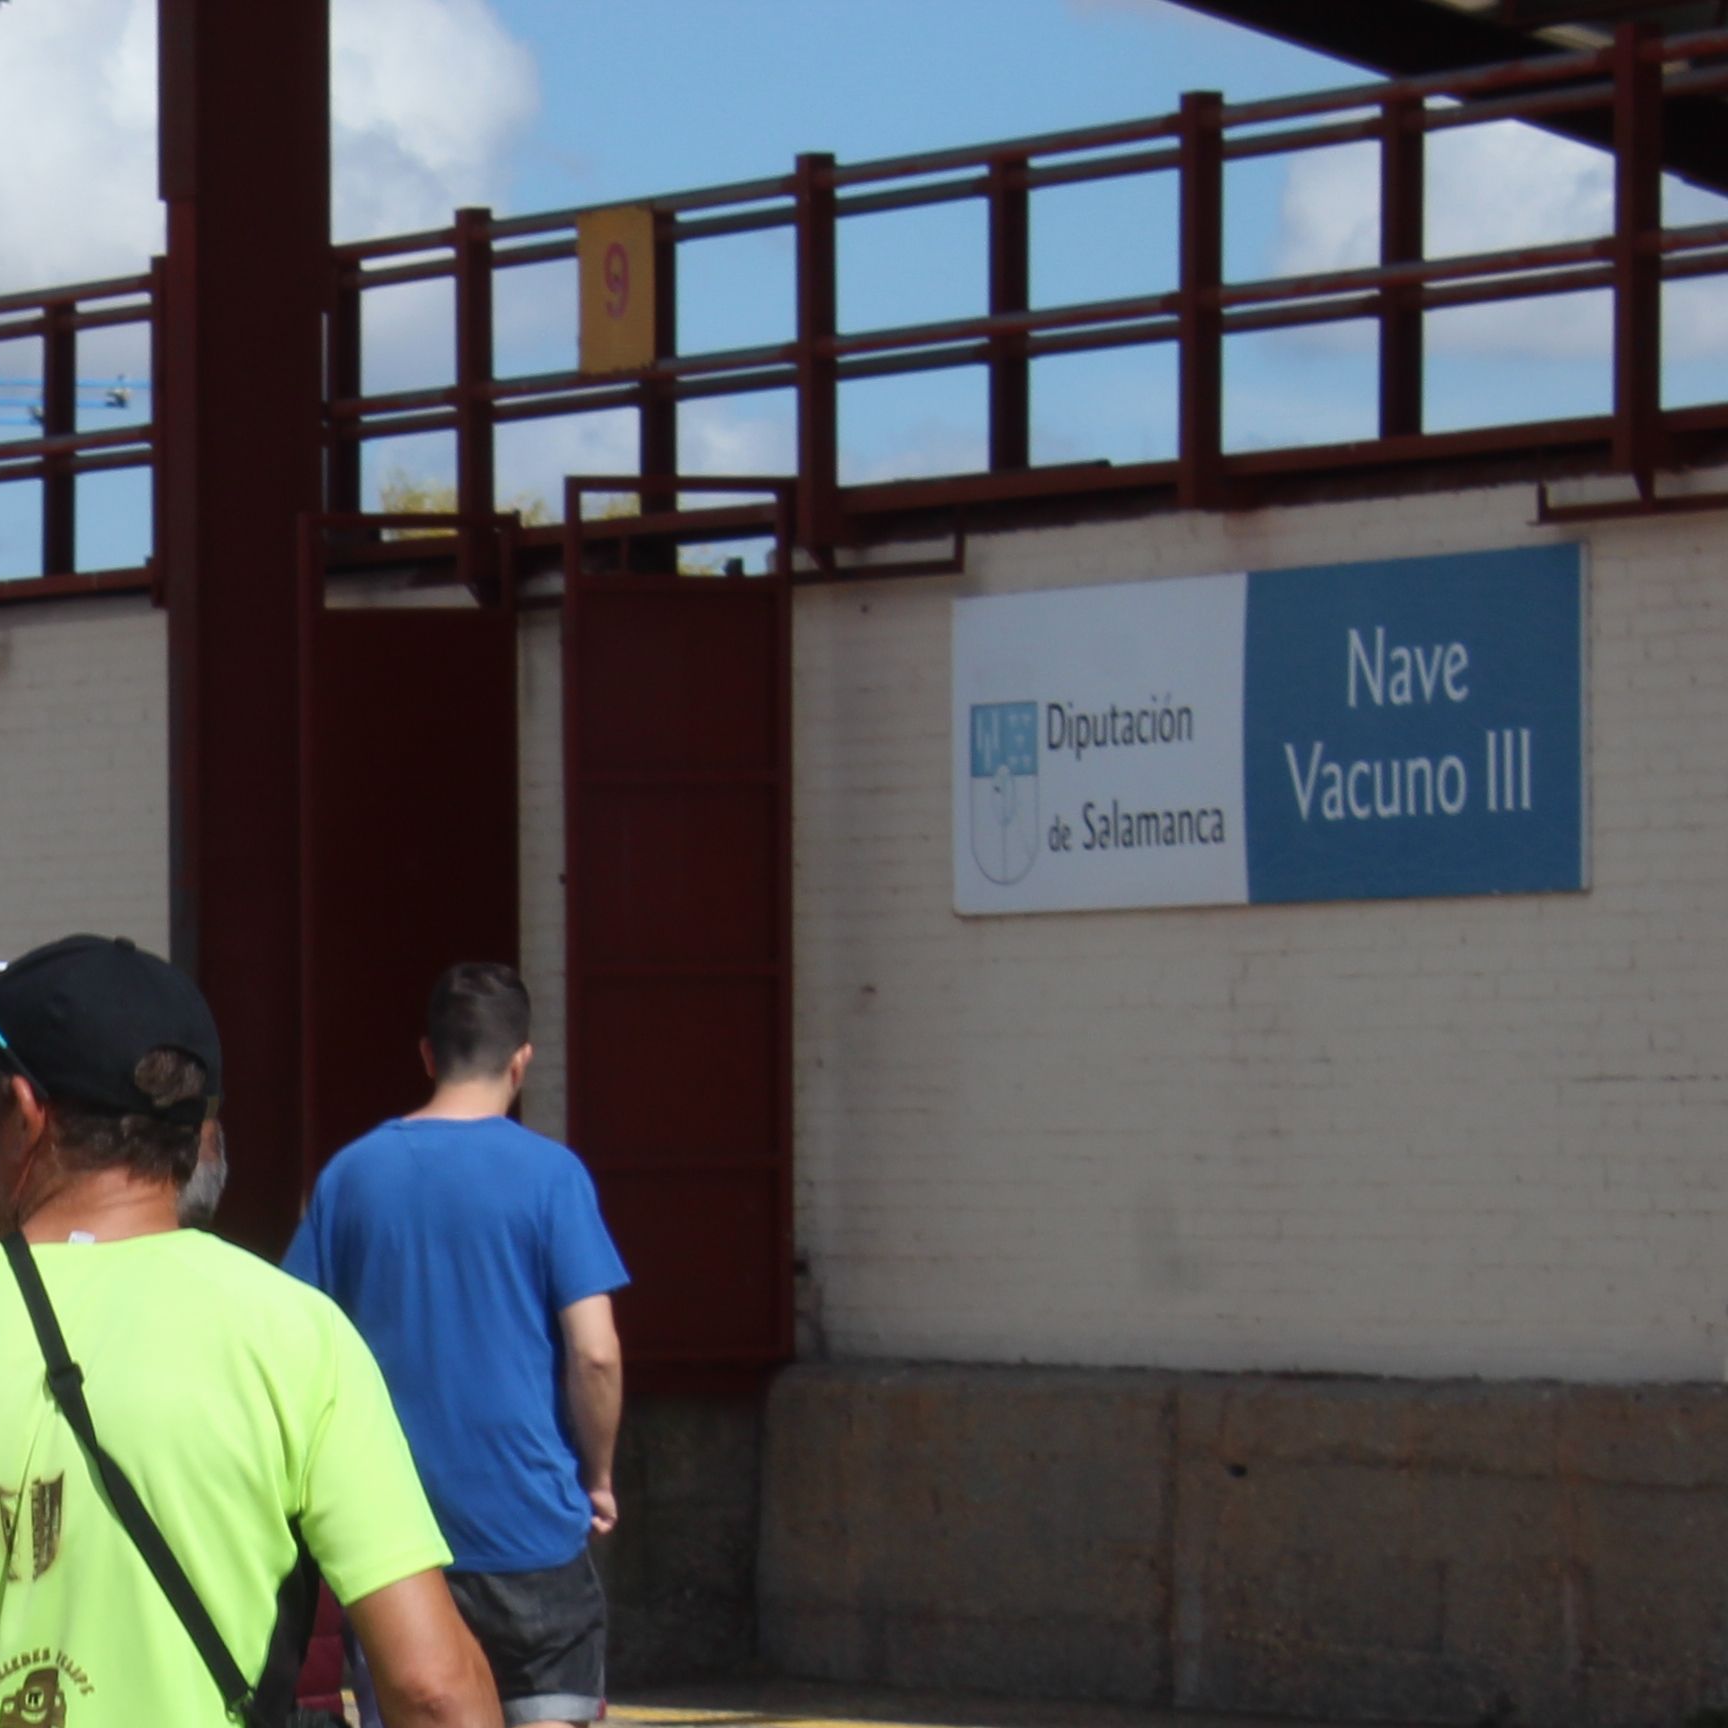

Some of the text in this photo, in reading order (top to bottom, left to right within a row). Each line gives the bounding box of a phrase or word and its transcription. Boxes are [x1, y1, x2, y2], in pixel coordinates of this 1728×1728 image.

[604, 240, 631, 320] 9
[1347, 626, 1469, 709] Nave
[1046, 692, 1195, 761] Diputación
[1285, 728, 1533, 821] Vacuno III
[1048, 802, 1227, 854] de Salamanca
